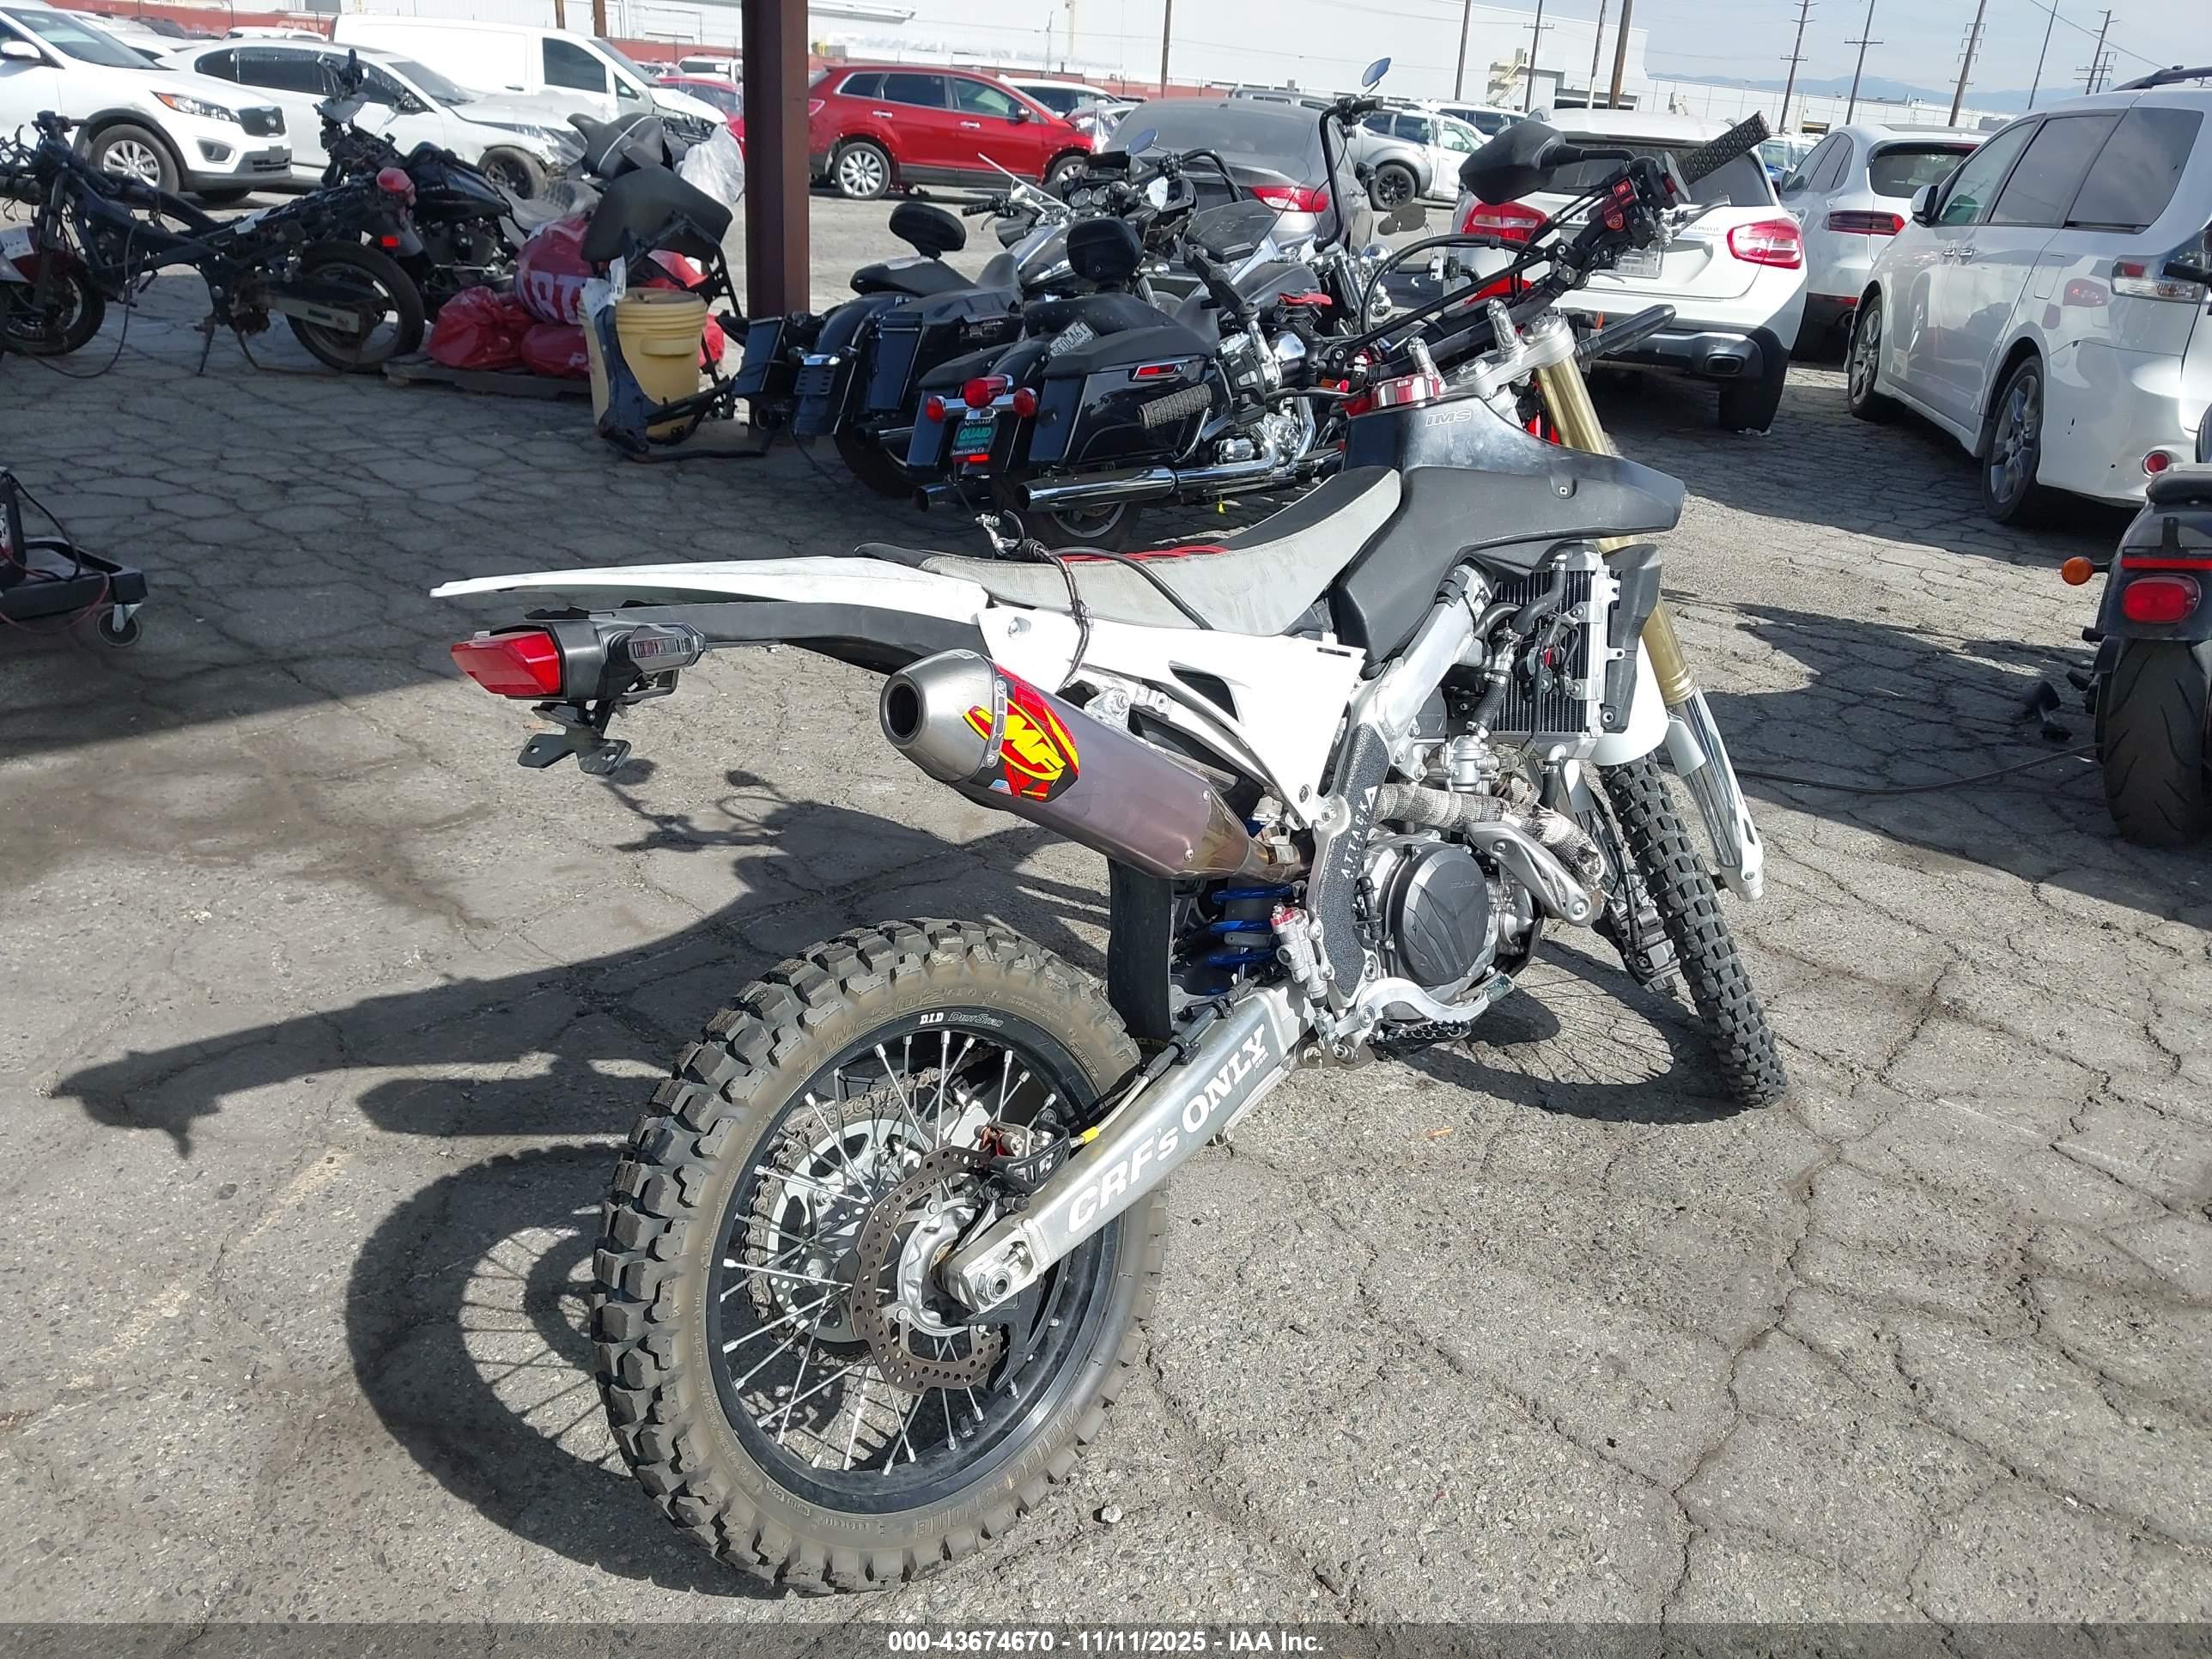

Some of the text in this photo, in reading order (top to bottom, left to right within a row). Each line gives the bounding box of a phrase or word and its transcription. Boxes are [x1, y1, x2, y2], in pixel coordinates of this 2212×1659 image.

[1425, 409, 1472, 427] IMS
[959, 428, 991, 440] QUAID
[1341, 799, 1370, 880] ATTACK
[920, 1012, 945, 1025] D.I.D
[1068, 1023, 1269, 1233] CRF's ONLY .com
